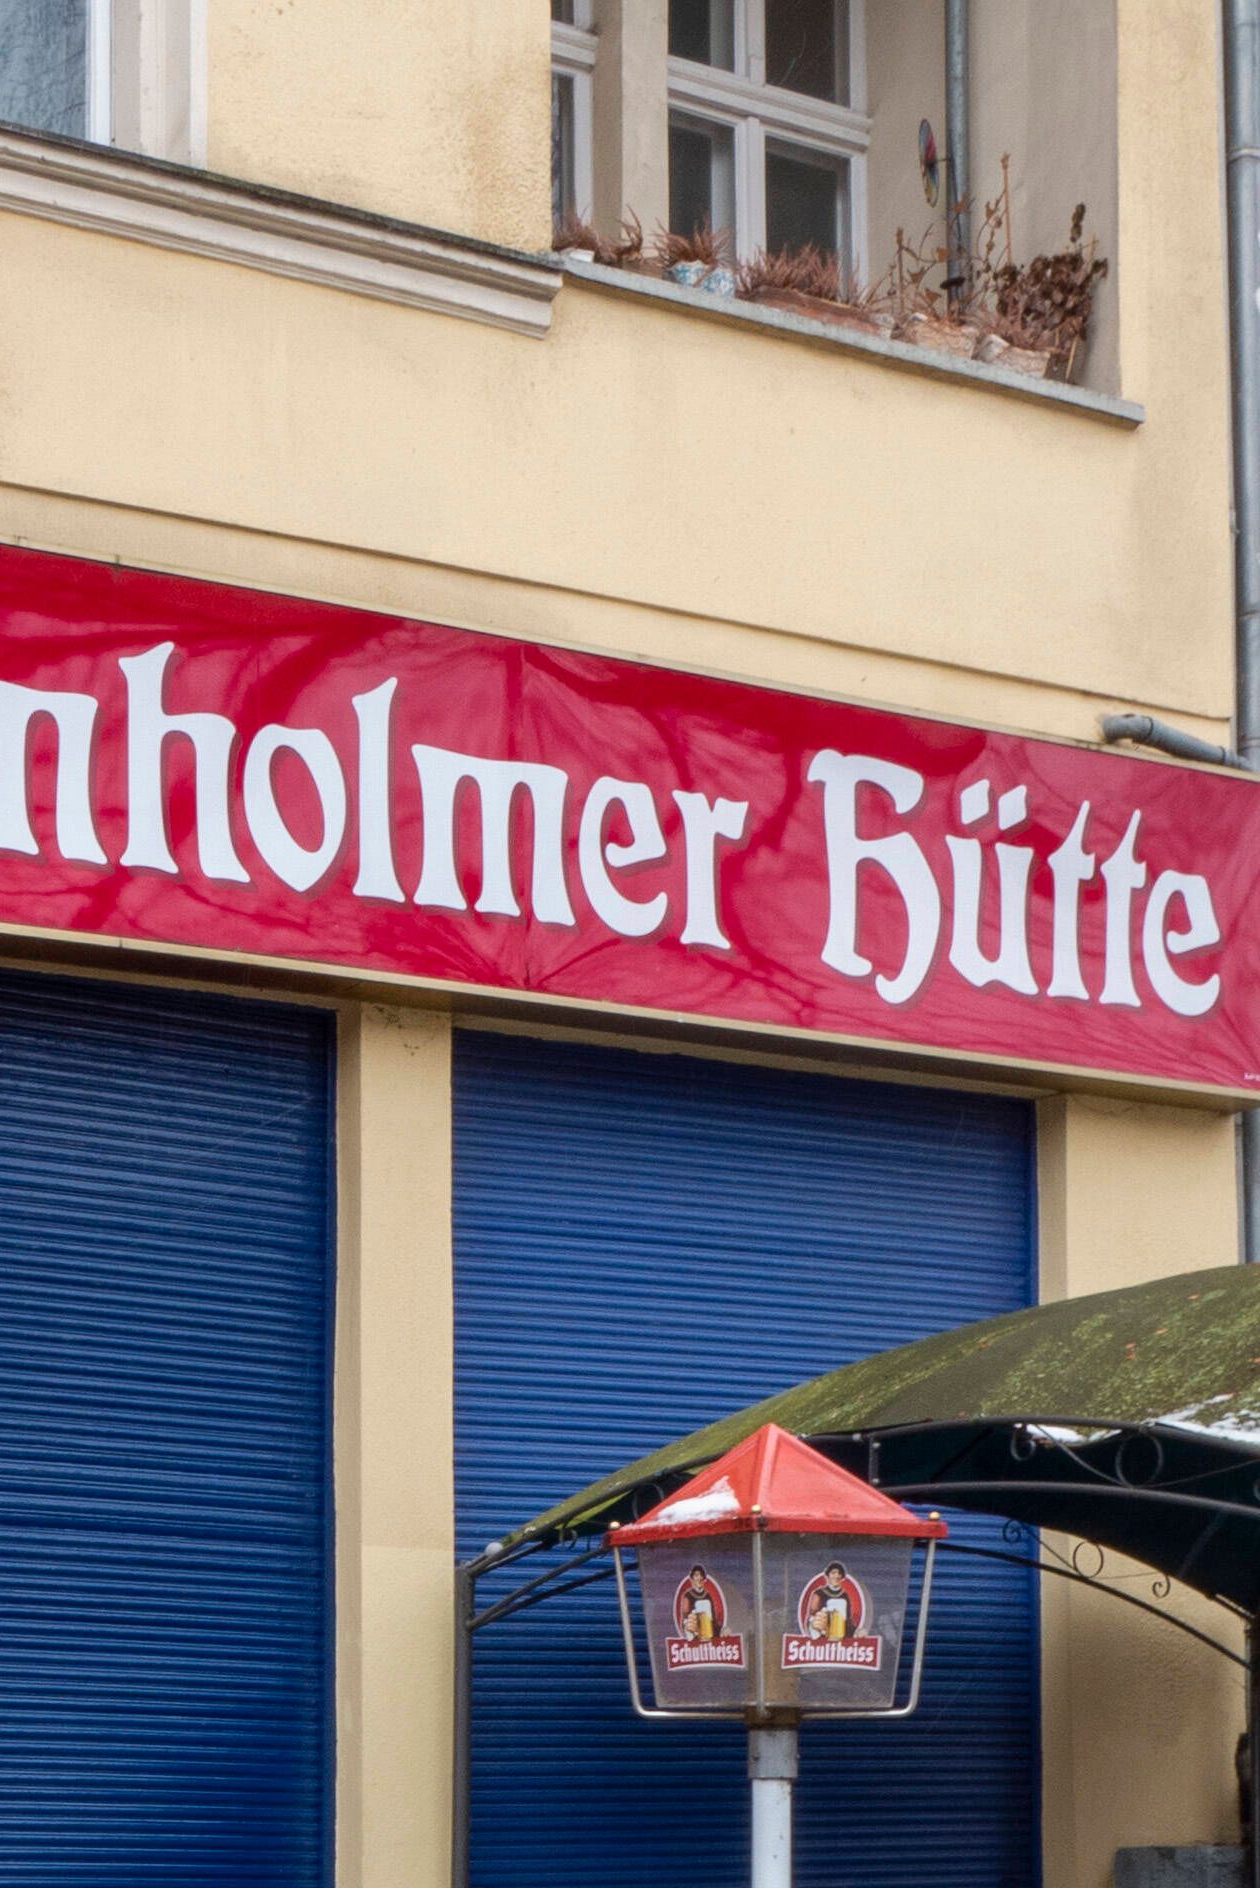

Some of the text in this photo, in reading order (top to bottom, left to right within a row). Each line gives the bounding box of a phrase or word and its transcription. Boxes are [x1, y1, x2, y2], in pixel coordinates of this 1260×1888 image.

[806, 748, 1221, 1017] Hütte
[671, 1642, 741, 1663] Schultheiss
[787, 1640, 875, 1663] Schultheiss
